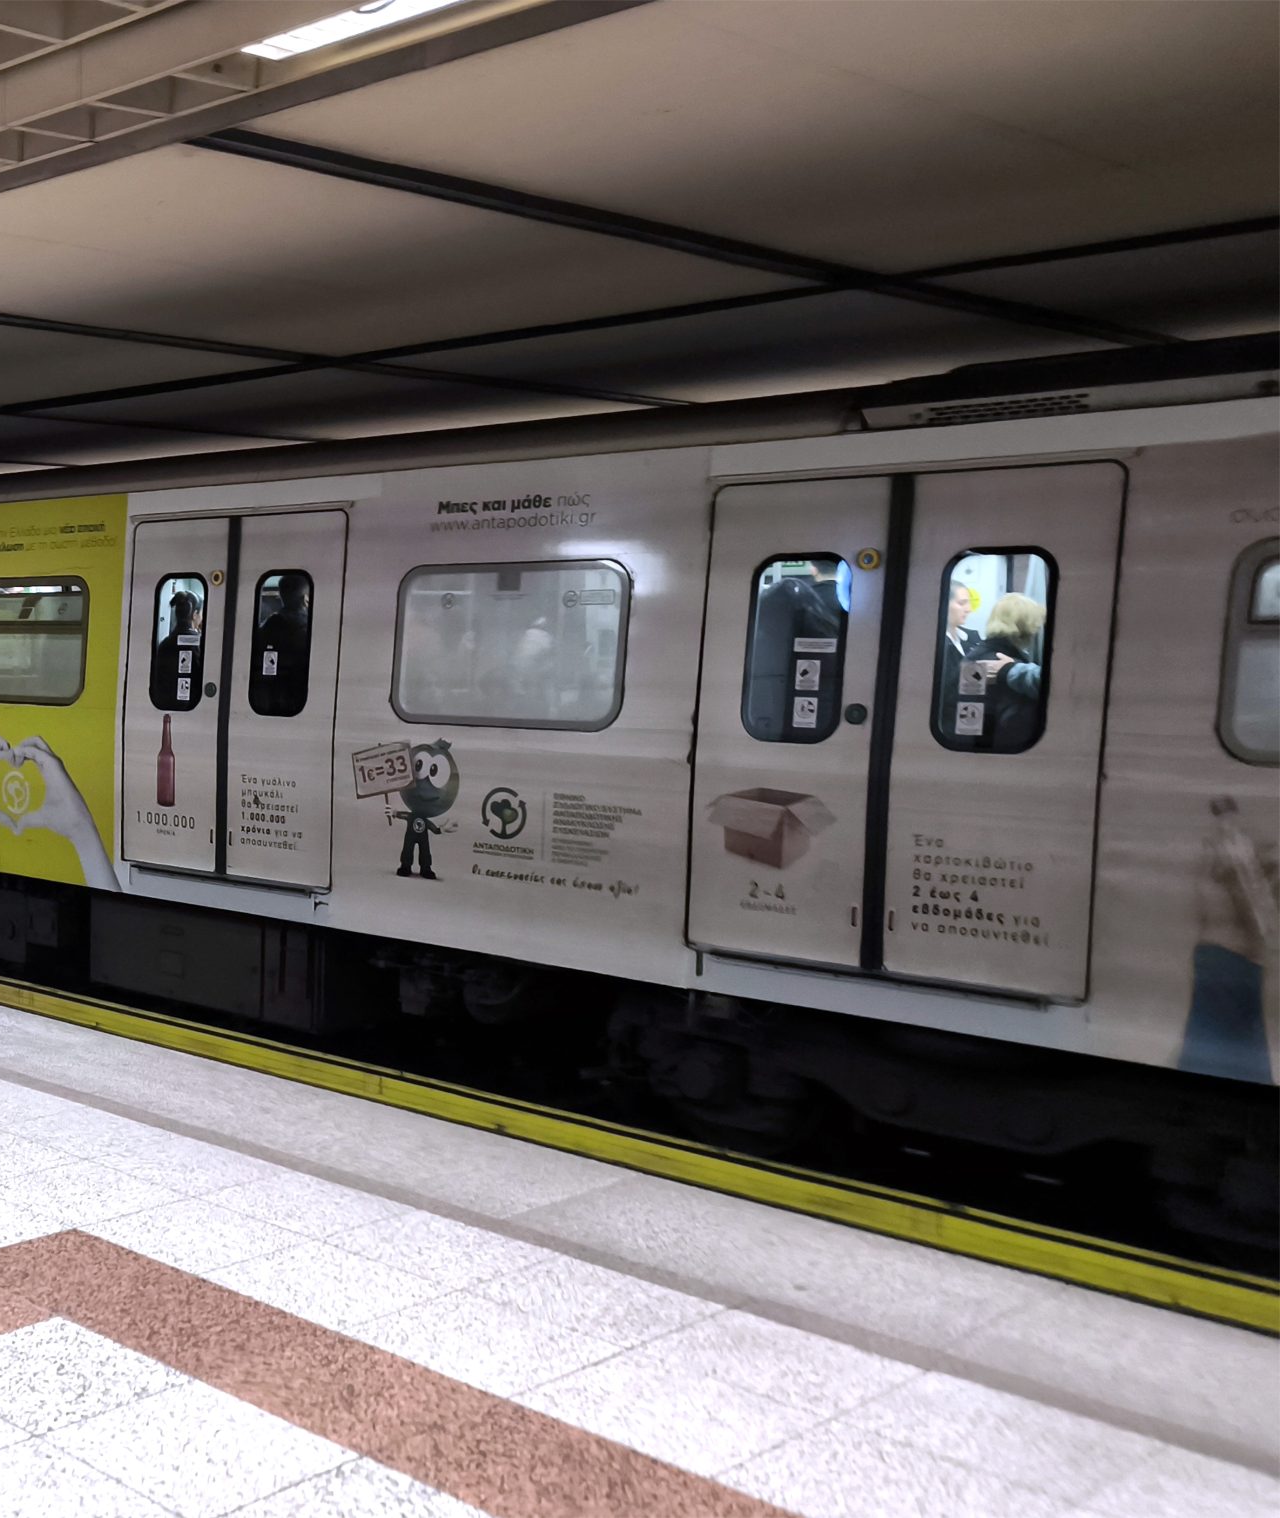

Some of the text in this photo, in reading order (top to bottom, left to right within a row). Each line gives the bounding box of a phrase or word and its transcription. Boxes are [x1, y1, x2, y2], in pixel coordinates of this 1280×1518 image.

[437, 491, 591, 515] Μπες και μάθε πώς
[429, 511, 597, 532] www.antapodotiki.gr
[359, 755, 408, 783] 1€=33
[241, 798, 252, 808] θα
[137, 810, 195, 829] 1.000.000
[241, 825, 303, 839] χρόνια για να
[913, 853, 1033, 872] χαρτοκιβώτιο
[912, 868, 1024, 889] θα χρειαστεί
[912, 884, 979, 903] 2 έως 4
[911, 902, 1040, 929] εβδομάδες για
[911, 921, 929, 933] να
